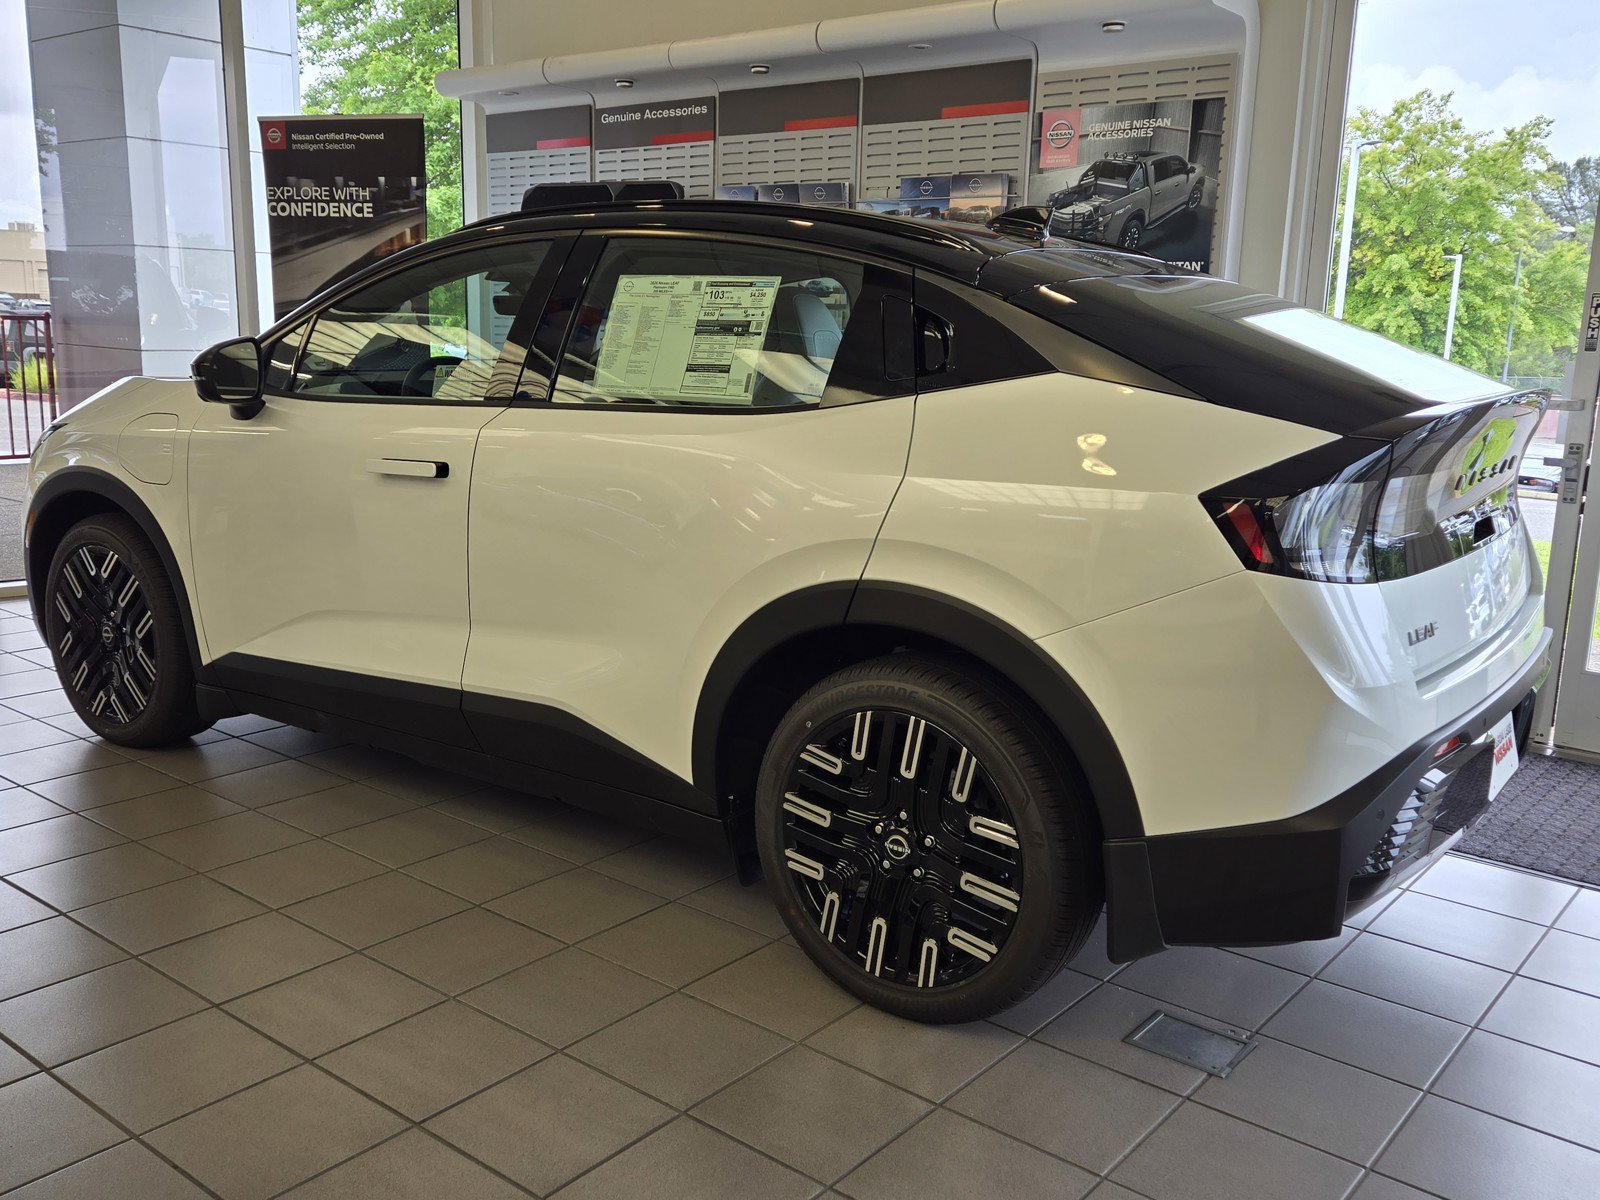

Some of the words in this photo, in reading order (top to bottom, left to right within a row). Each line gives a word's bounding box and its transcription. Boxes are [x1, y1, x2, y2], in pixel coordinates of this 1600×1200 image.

[601, 111, 641, 124] Genuine
[643, 105, 708, 120] Accessories
[1088, 120, 1131, 132] GENUINE
[1132, 117, 1172, 129] NISSAN
[315, 132, 344, 140] Certified
[345, 132, 385, 140] Pre-Owned
[1087, 127, 1154, 141] ACCESSORIES
[291, 142, 324, 151] Intelligent
[325, 142, 356, 150] Selection
[267, 187, 330, 200] EXPLORE
[331, 187, 370, 200] WITH
[268, 202, 374, 218] CONFIDENCE
[1167, 261, 1201, 272] TAN
[709, 290, 725, 300] 103
[1587, 297, 1600, 339] PUSH
[1454, 454, 1518, 491] NISSAN
[1407, 622, 1440, 647] LEAF
